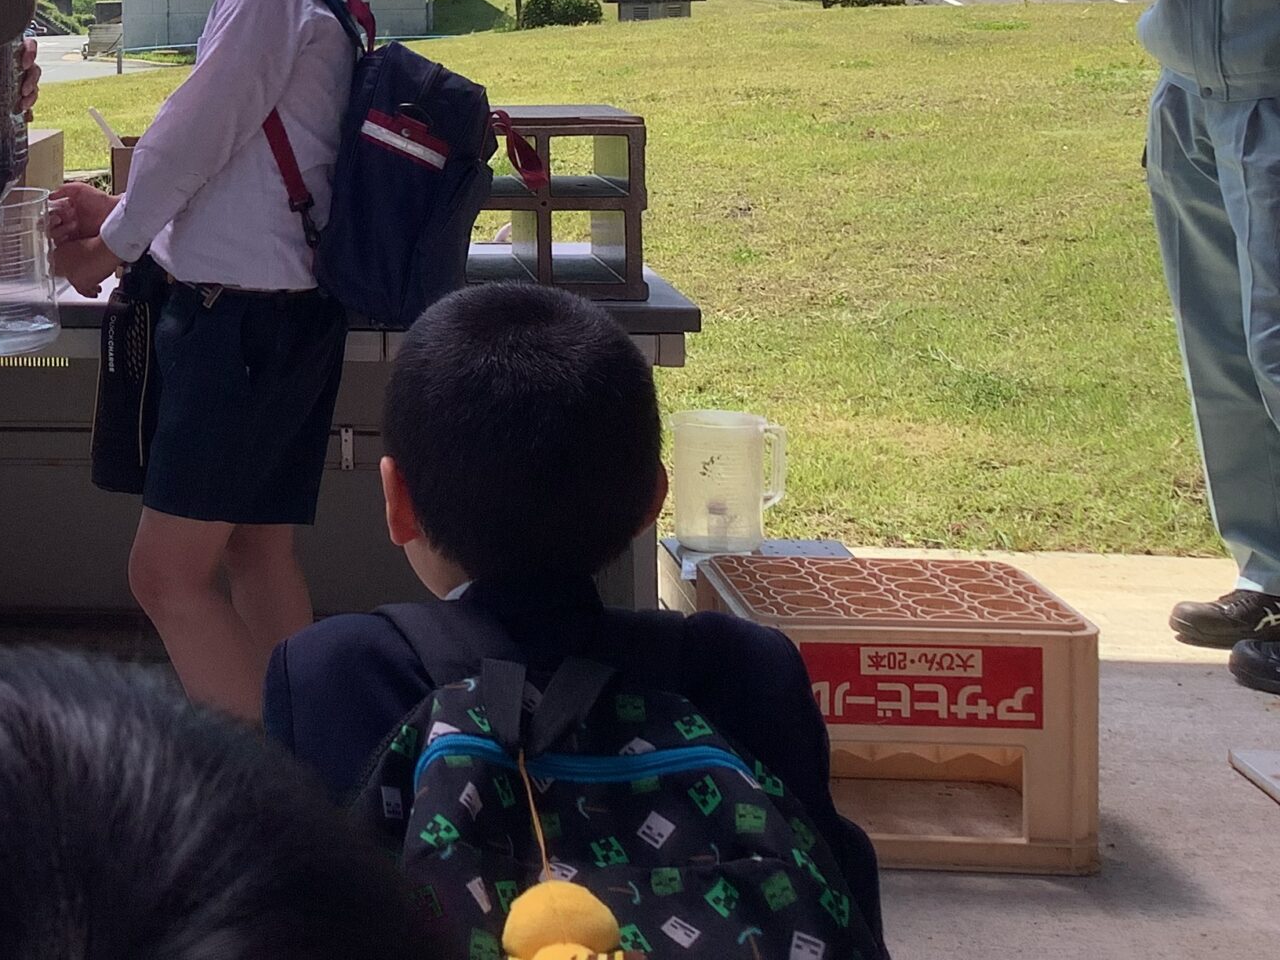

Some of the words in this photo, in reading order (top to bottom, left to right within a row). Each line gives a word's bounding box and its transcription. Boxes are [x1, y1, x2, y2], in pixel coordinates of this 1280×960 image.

[866, 651, 975, 671] 大びん・20本
[810, 681, 1036, 721] アサヒビール
